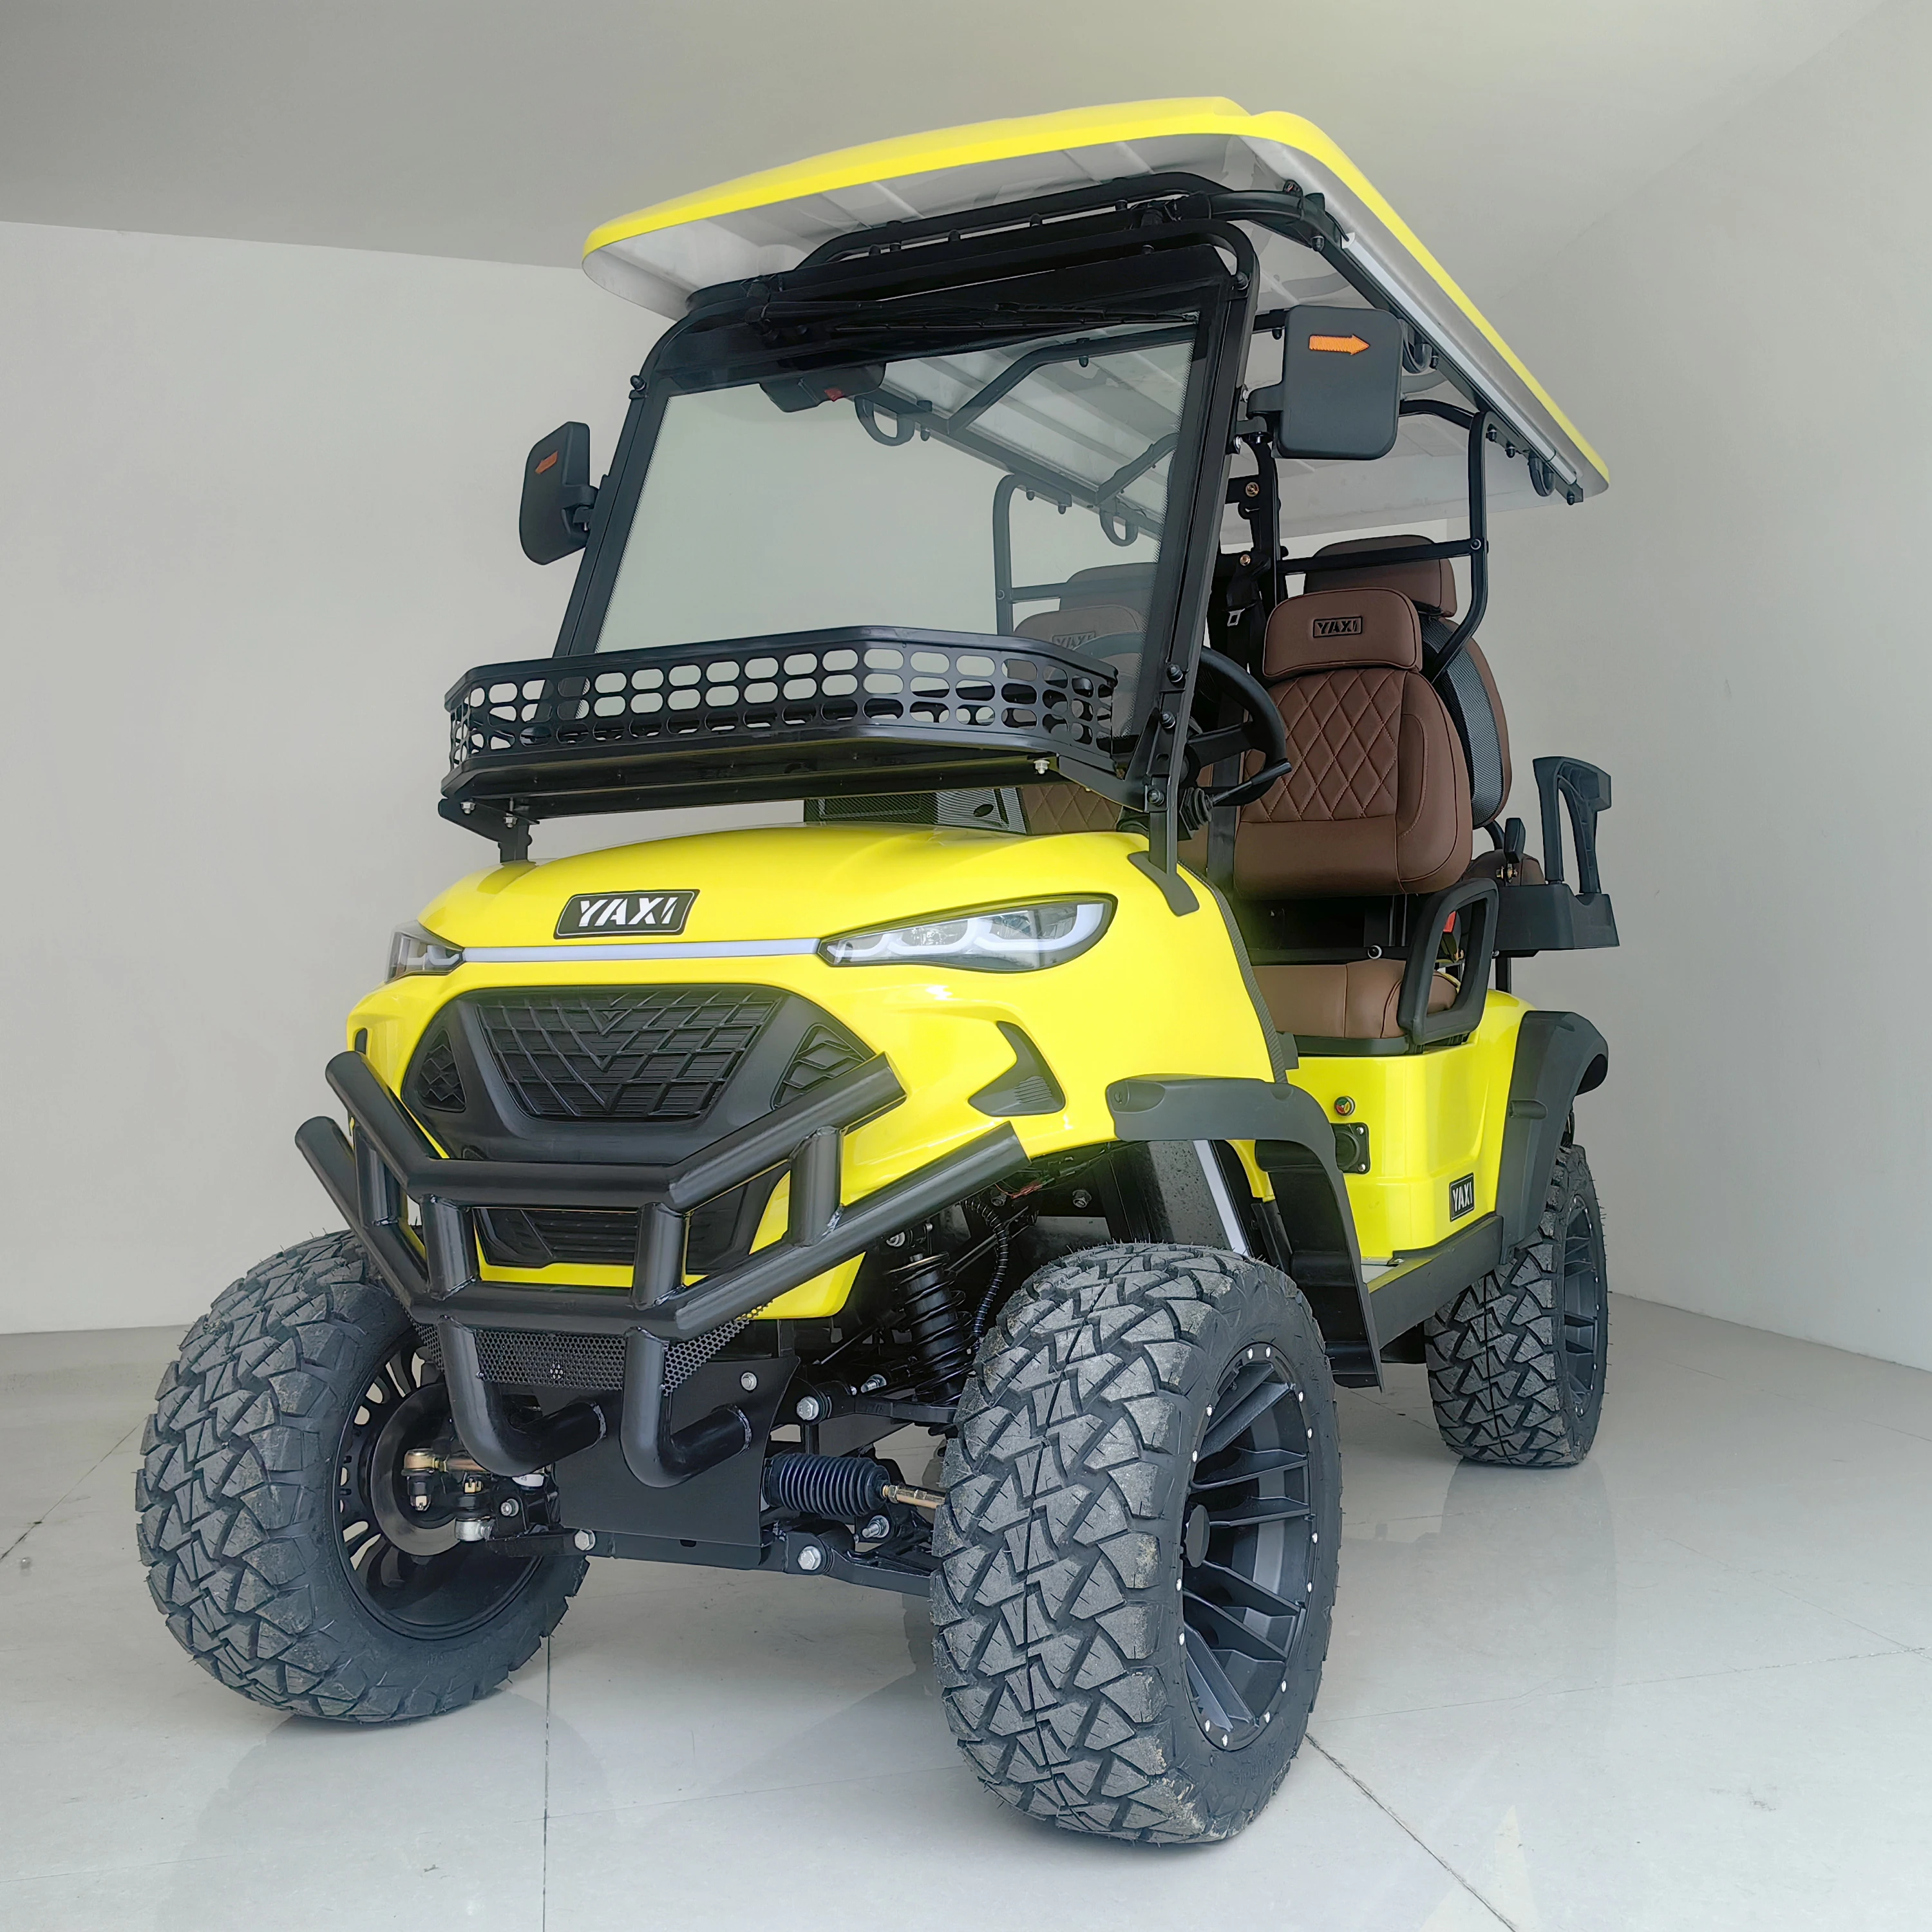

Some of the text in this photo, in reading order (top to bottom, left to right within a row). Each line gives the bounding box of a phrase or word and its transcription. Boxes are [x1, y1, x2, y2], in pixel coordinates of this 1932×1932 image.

[1317, 620, 1358, 634] YAXI
[578, 897, 678, 927] YAXI
[1452, 1181, 1472, 1212] YAXI
